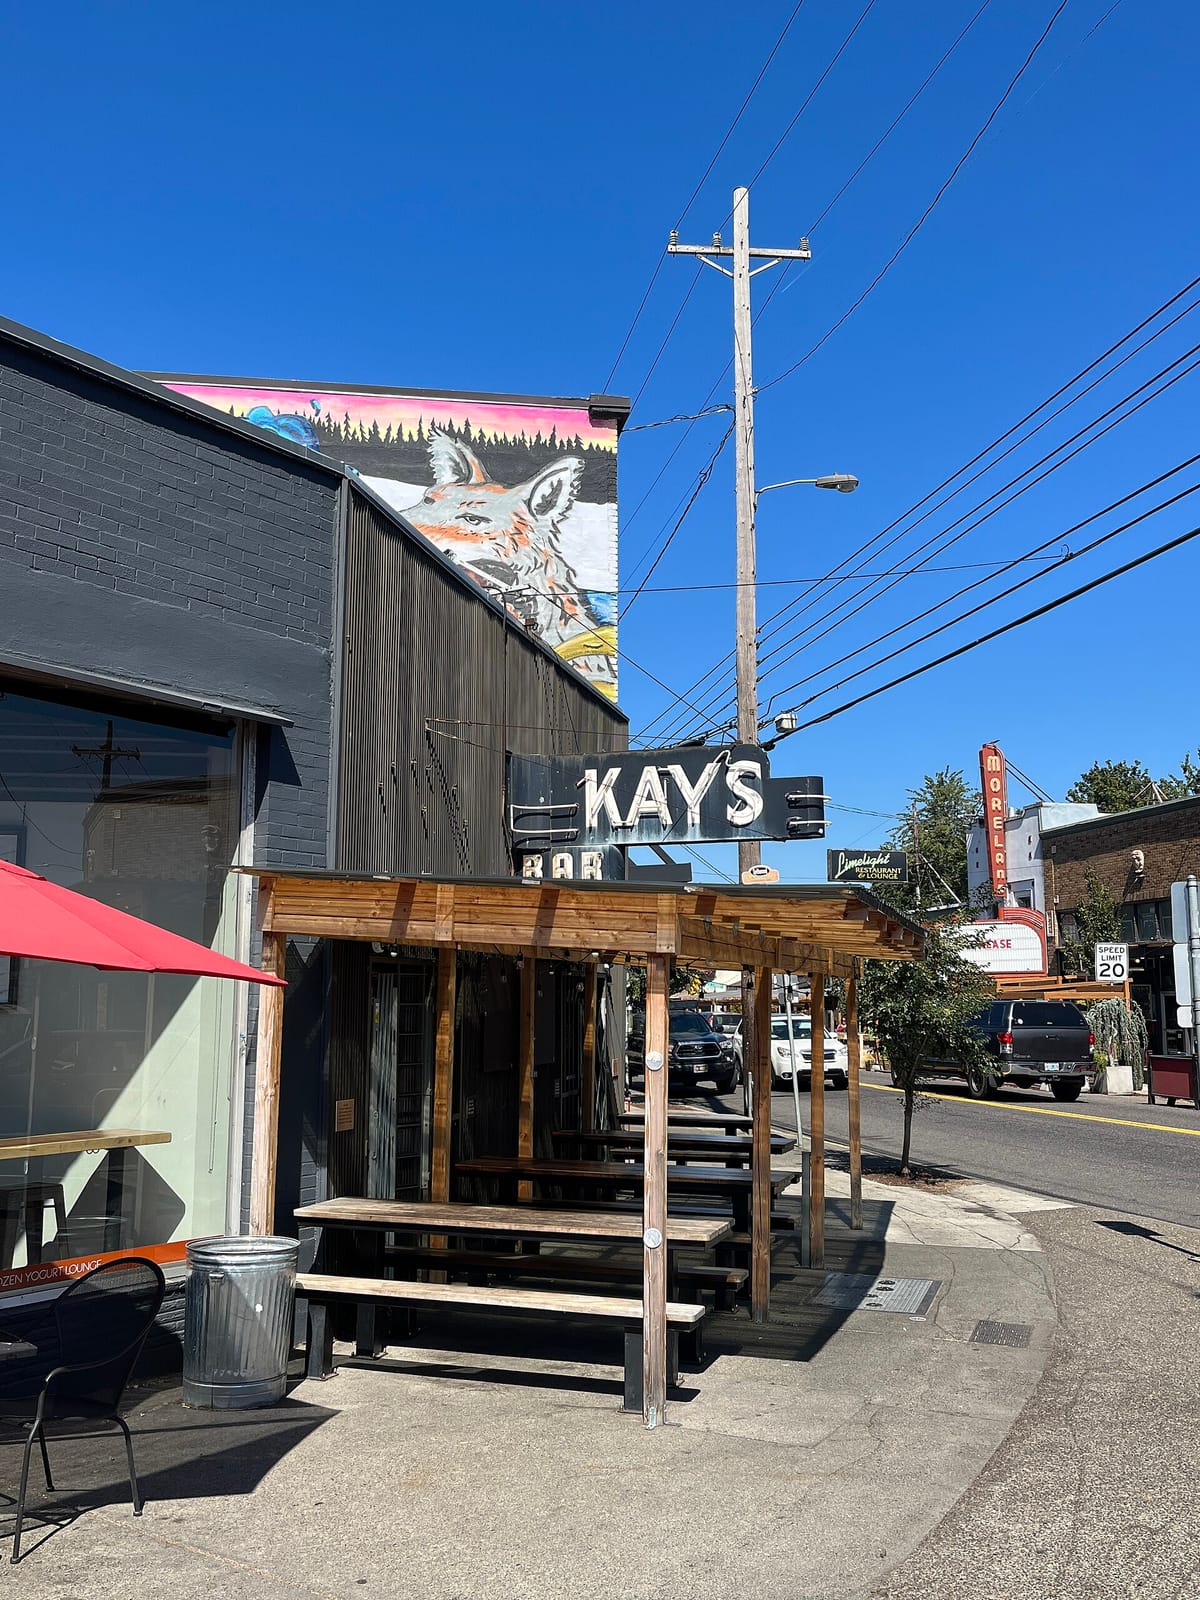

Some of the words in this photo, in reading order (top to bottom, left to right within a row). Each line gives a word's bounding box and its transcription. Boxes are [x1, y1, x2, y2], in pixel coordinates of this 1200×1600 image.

[584, 750, 764, 827] KAY'S
[522, 851, 604, 880] BAR
[834, 852, 891, 879] Limelight
[1098, 946, 1125, 954] SPEED
[1099, 963, 1124, 977] 20
[25, 1266, 64, 1282] YOGURT
